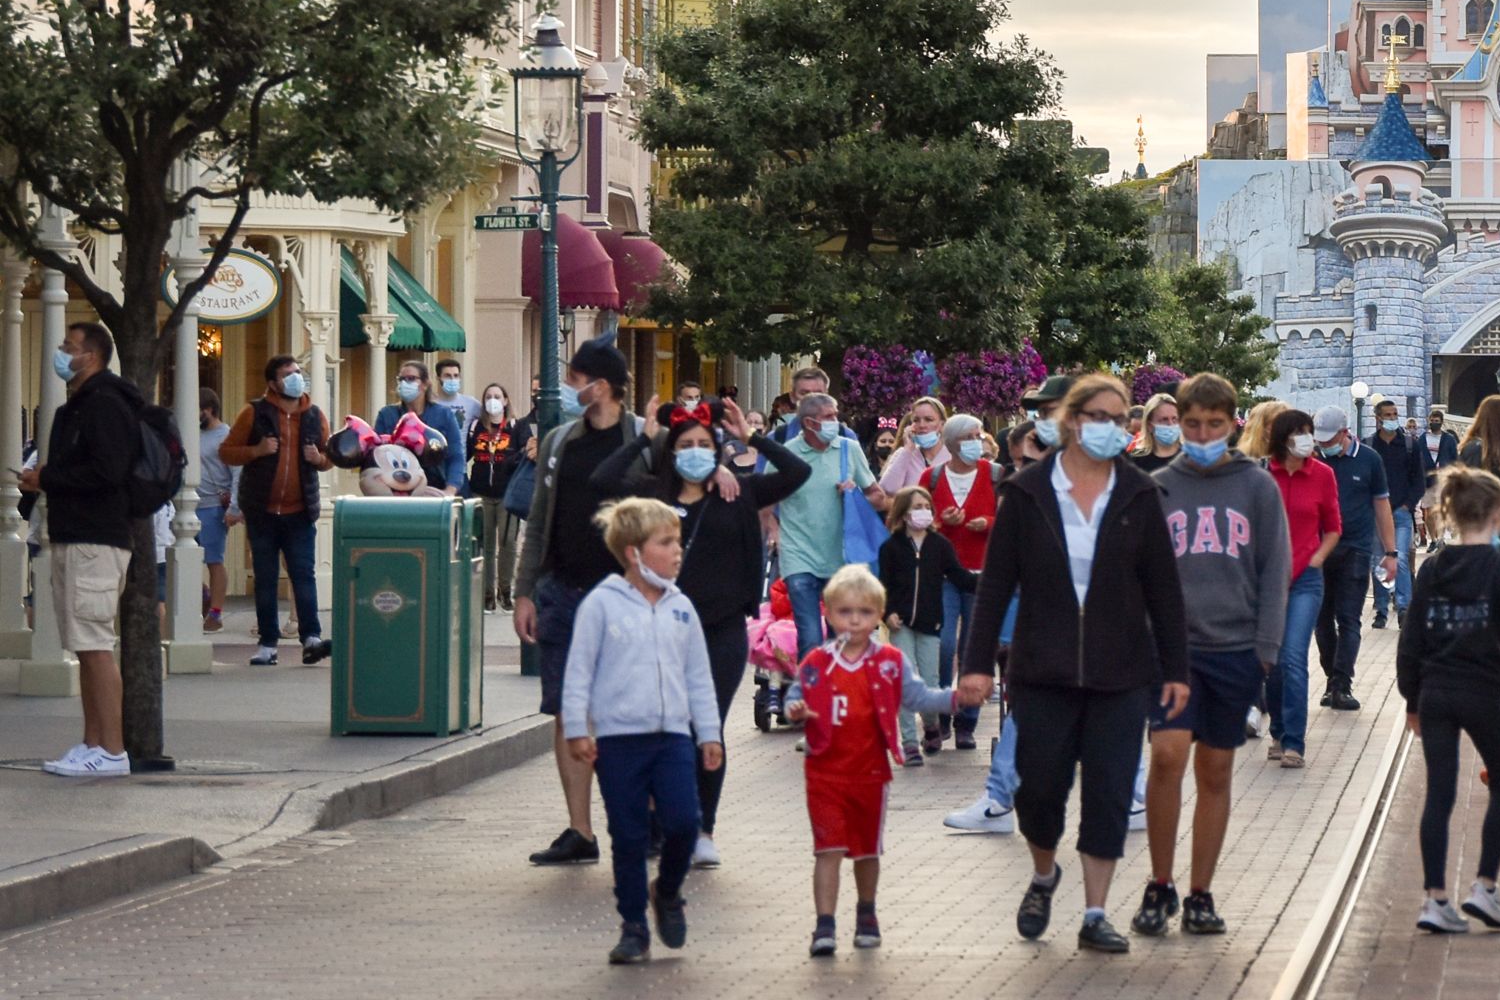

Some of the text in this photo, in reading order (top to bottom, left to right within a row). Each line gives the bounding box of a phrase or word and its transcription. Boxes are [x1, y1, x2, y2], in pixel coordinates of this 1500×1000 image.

[483, 216, 531, 228] FLOWER ST.
[197, 289, 261, 311] STAURANT
[1167, 506, 1250, 558] GAP
